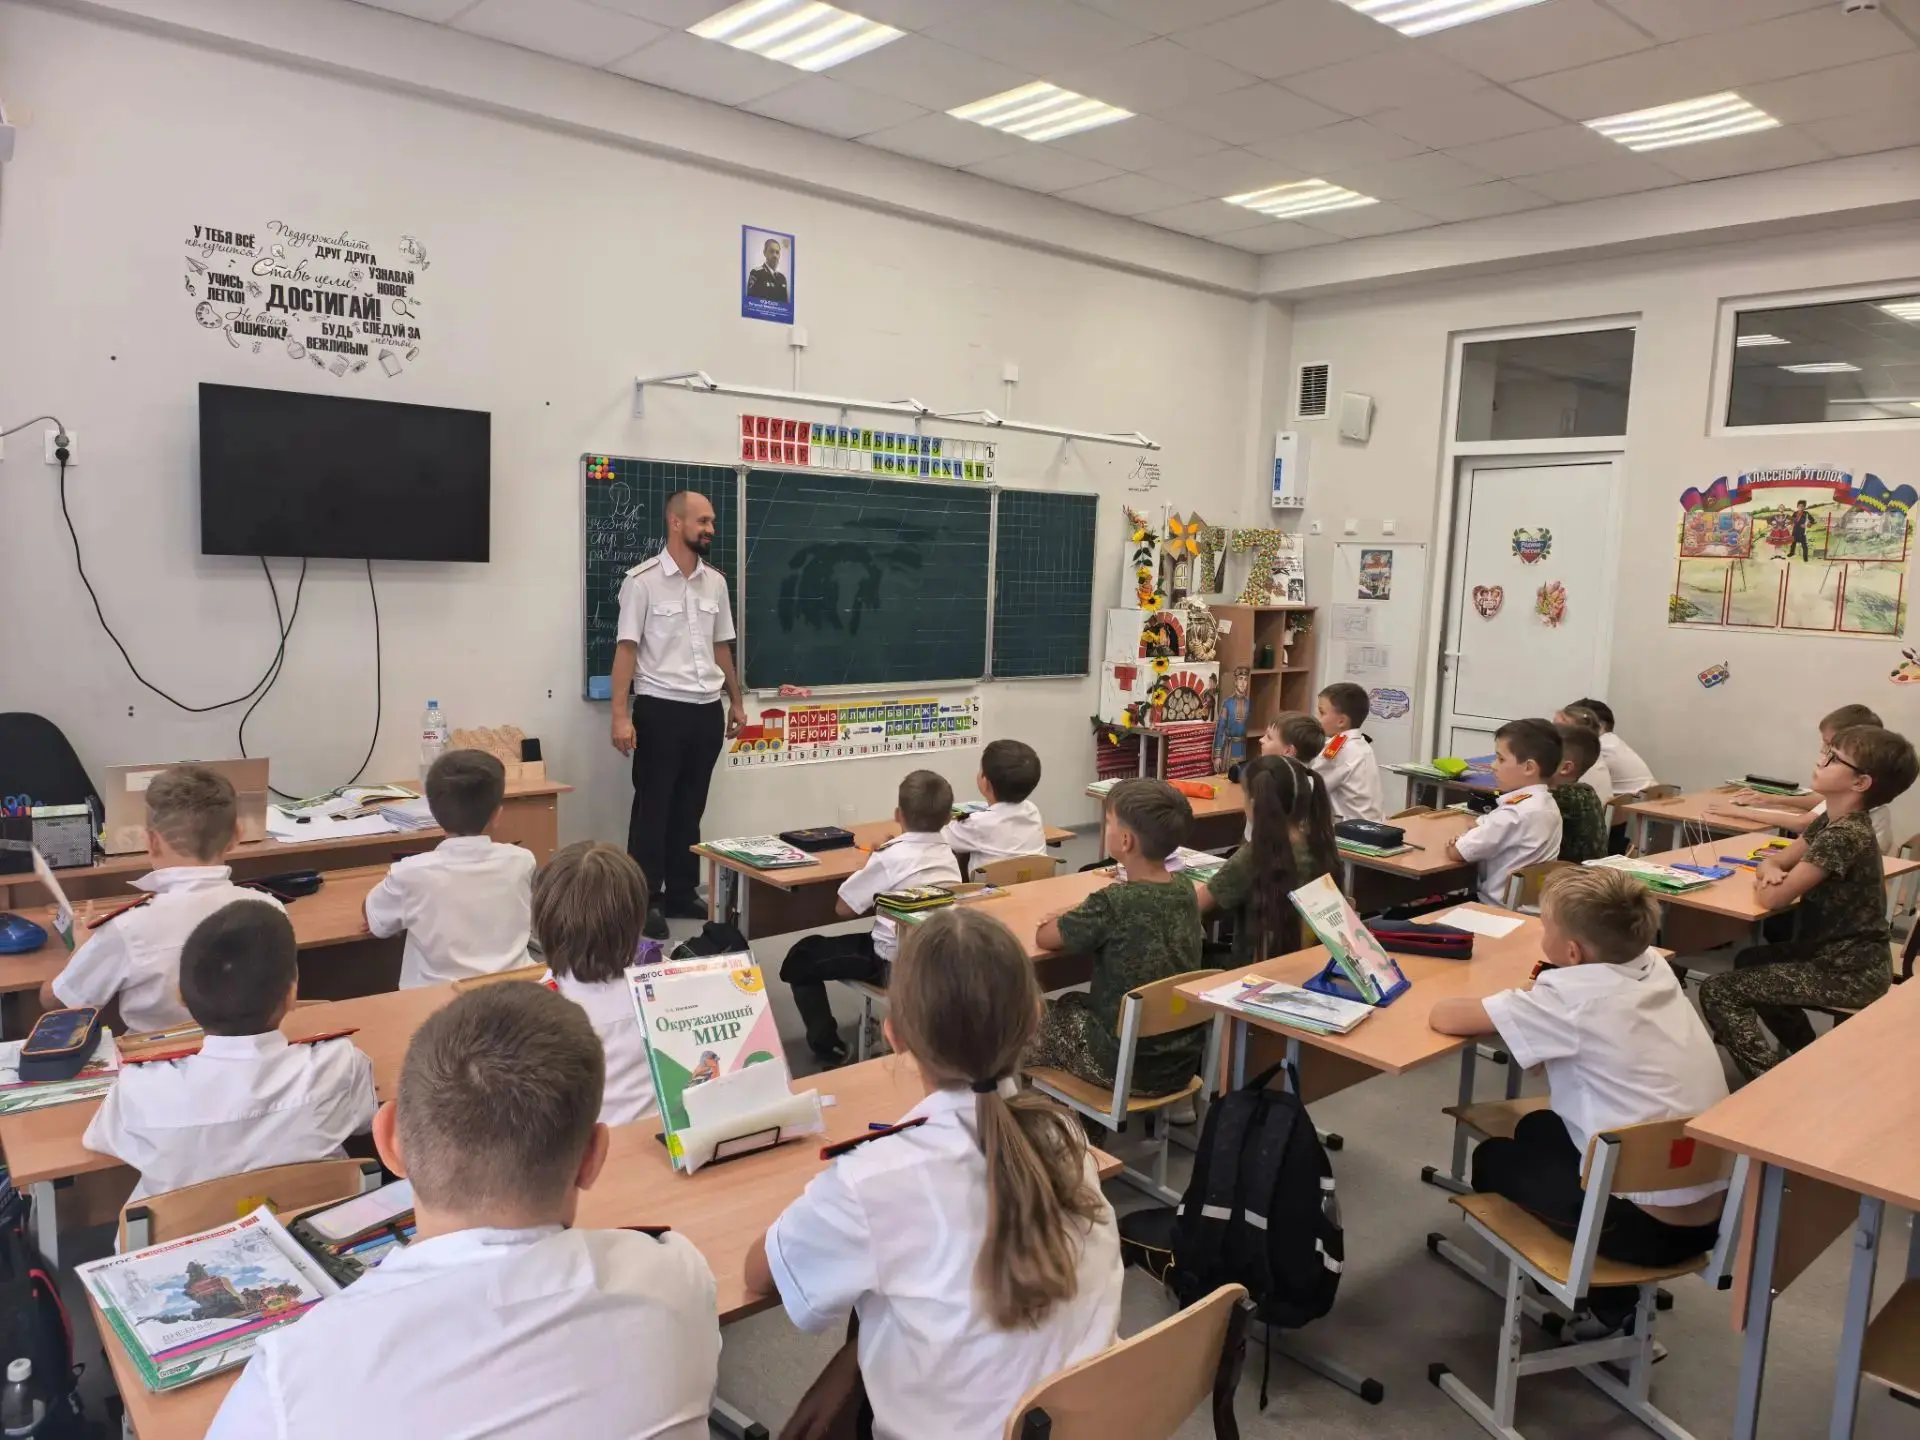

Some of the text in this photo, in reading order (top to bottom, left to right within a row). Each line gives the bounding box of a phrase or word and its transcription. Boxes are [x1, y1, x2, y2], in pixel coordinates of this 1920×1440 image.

[194, 225, 256, 249] У ТЕБЯ ВСЁ
[315, 245, 377, 266] ДРУГ ДРУГА
[252, 258, 312, 282] Ставь
[369, 266, 415, 285] УЗНАВАЙ
[207, 272, 244, 289] УЧИСЬ
[377, 282, 408, 298] НОВОЕ
[206, 286, 246, 304] ЛЕГКО!
[266, 283, 382, 322] ДОСТИГАЙ!
[234, 320, 288, 340] ОШИБОК!
[322, 322, 354, 340] БУДЬ
[362, 321, 421, 340] СЛЕДУЙ ЗА
[306, 336, 368, 356] ВЕЖЛИВЫМ
[1746, 468, 1844, 484] КЛАССНЫЙ УГОЛОК
[640, 970, 662, 978] ФГОС
[656, 1005, 754, 1032] Окружающий
[692, 1022, 742, 1046] МИР
